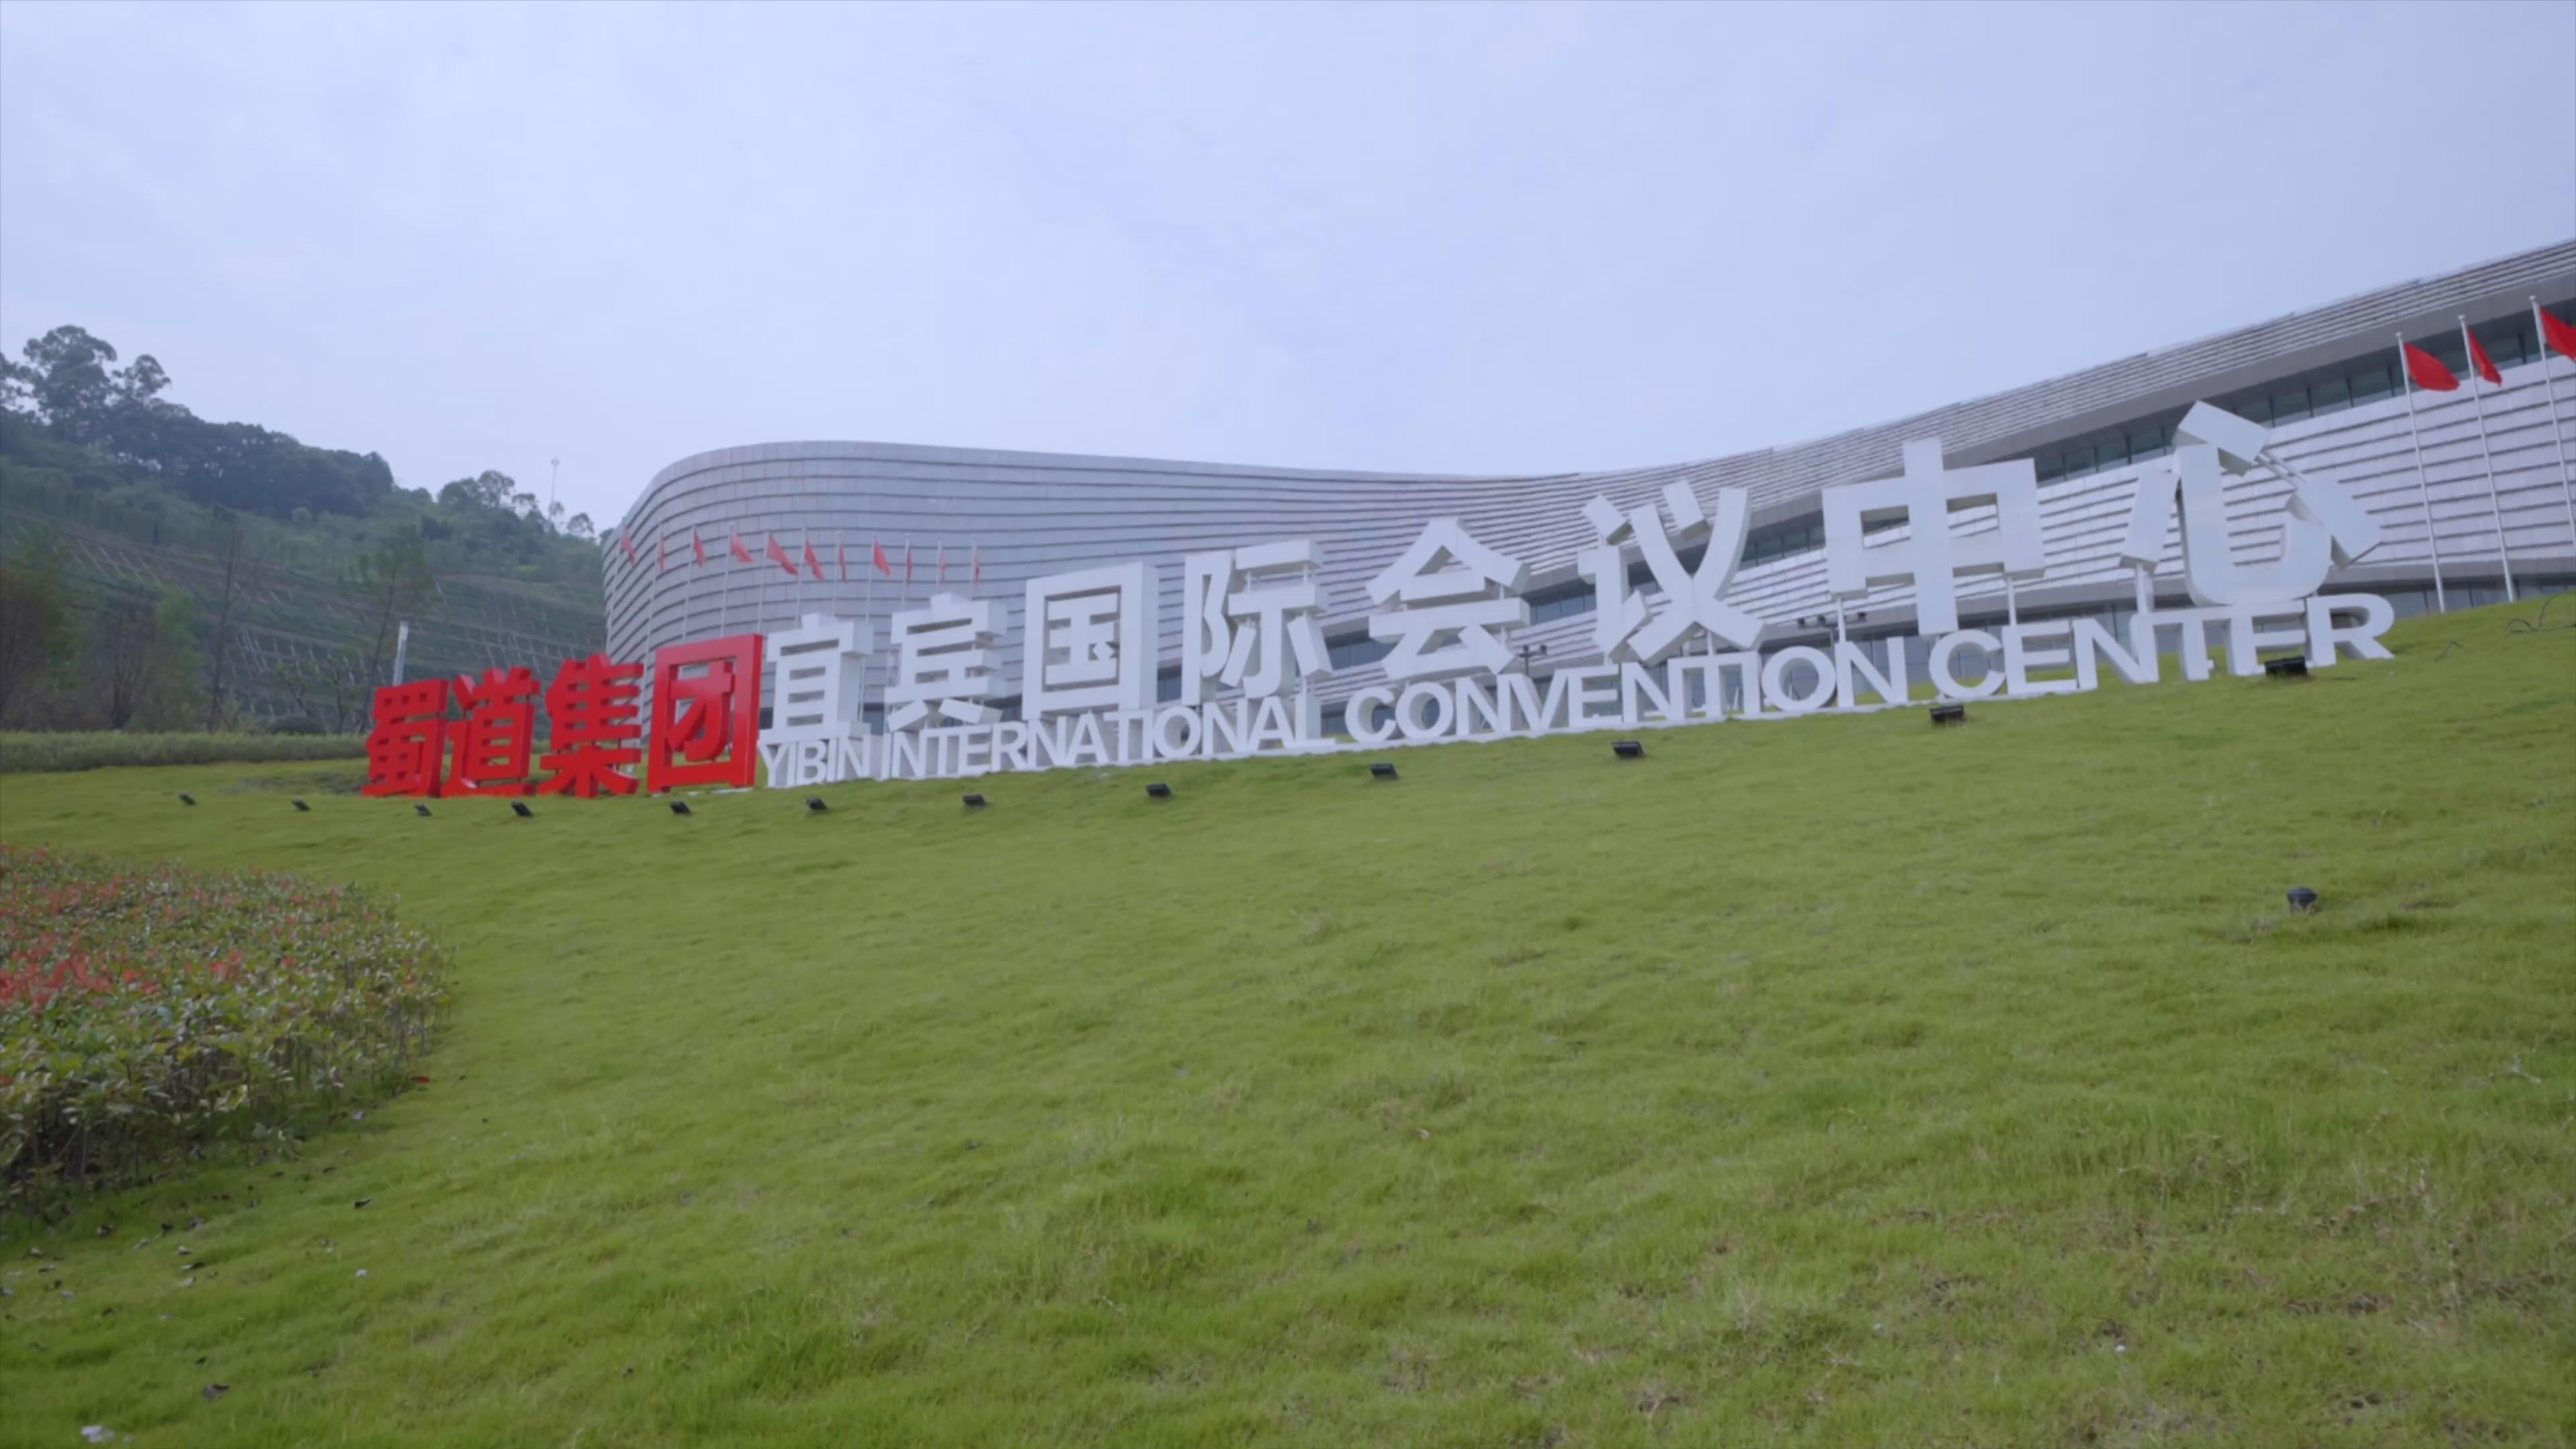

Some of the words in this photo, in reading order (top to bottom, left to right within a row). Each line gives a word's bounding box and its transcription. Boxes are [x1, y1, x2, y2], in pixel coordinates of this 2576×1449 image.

[758, 400, 2383, 739] 宜宾国际会议中心
[361, 633, 763, 798] 蜀道集团
[758, 737, 872, 788] YIBIN
[881, 692, 1335, 780] INTERNATIONAL
[1344, 636, 1909, 743] CONVENTION
[1929, 592, 2395, 700] CENTER
